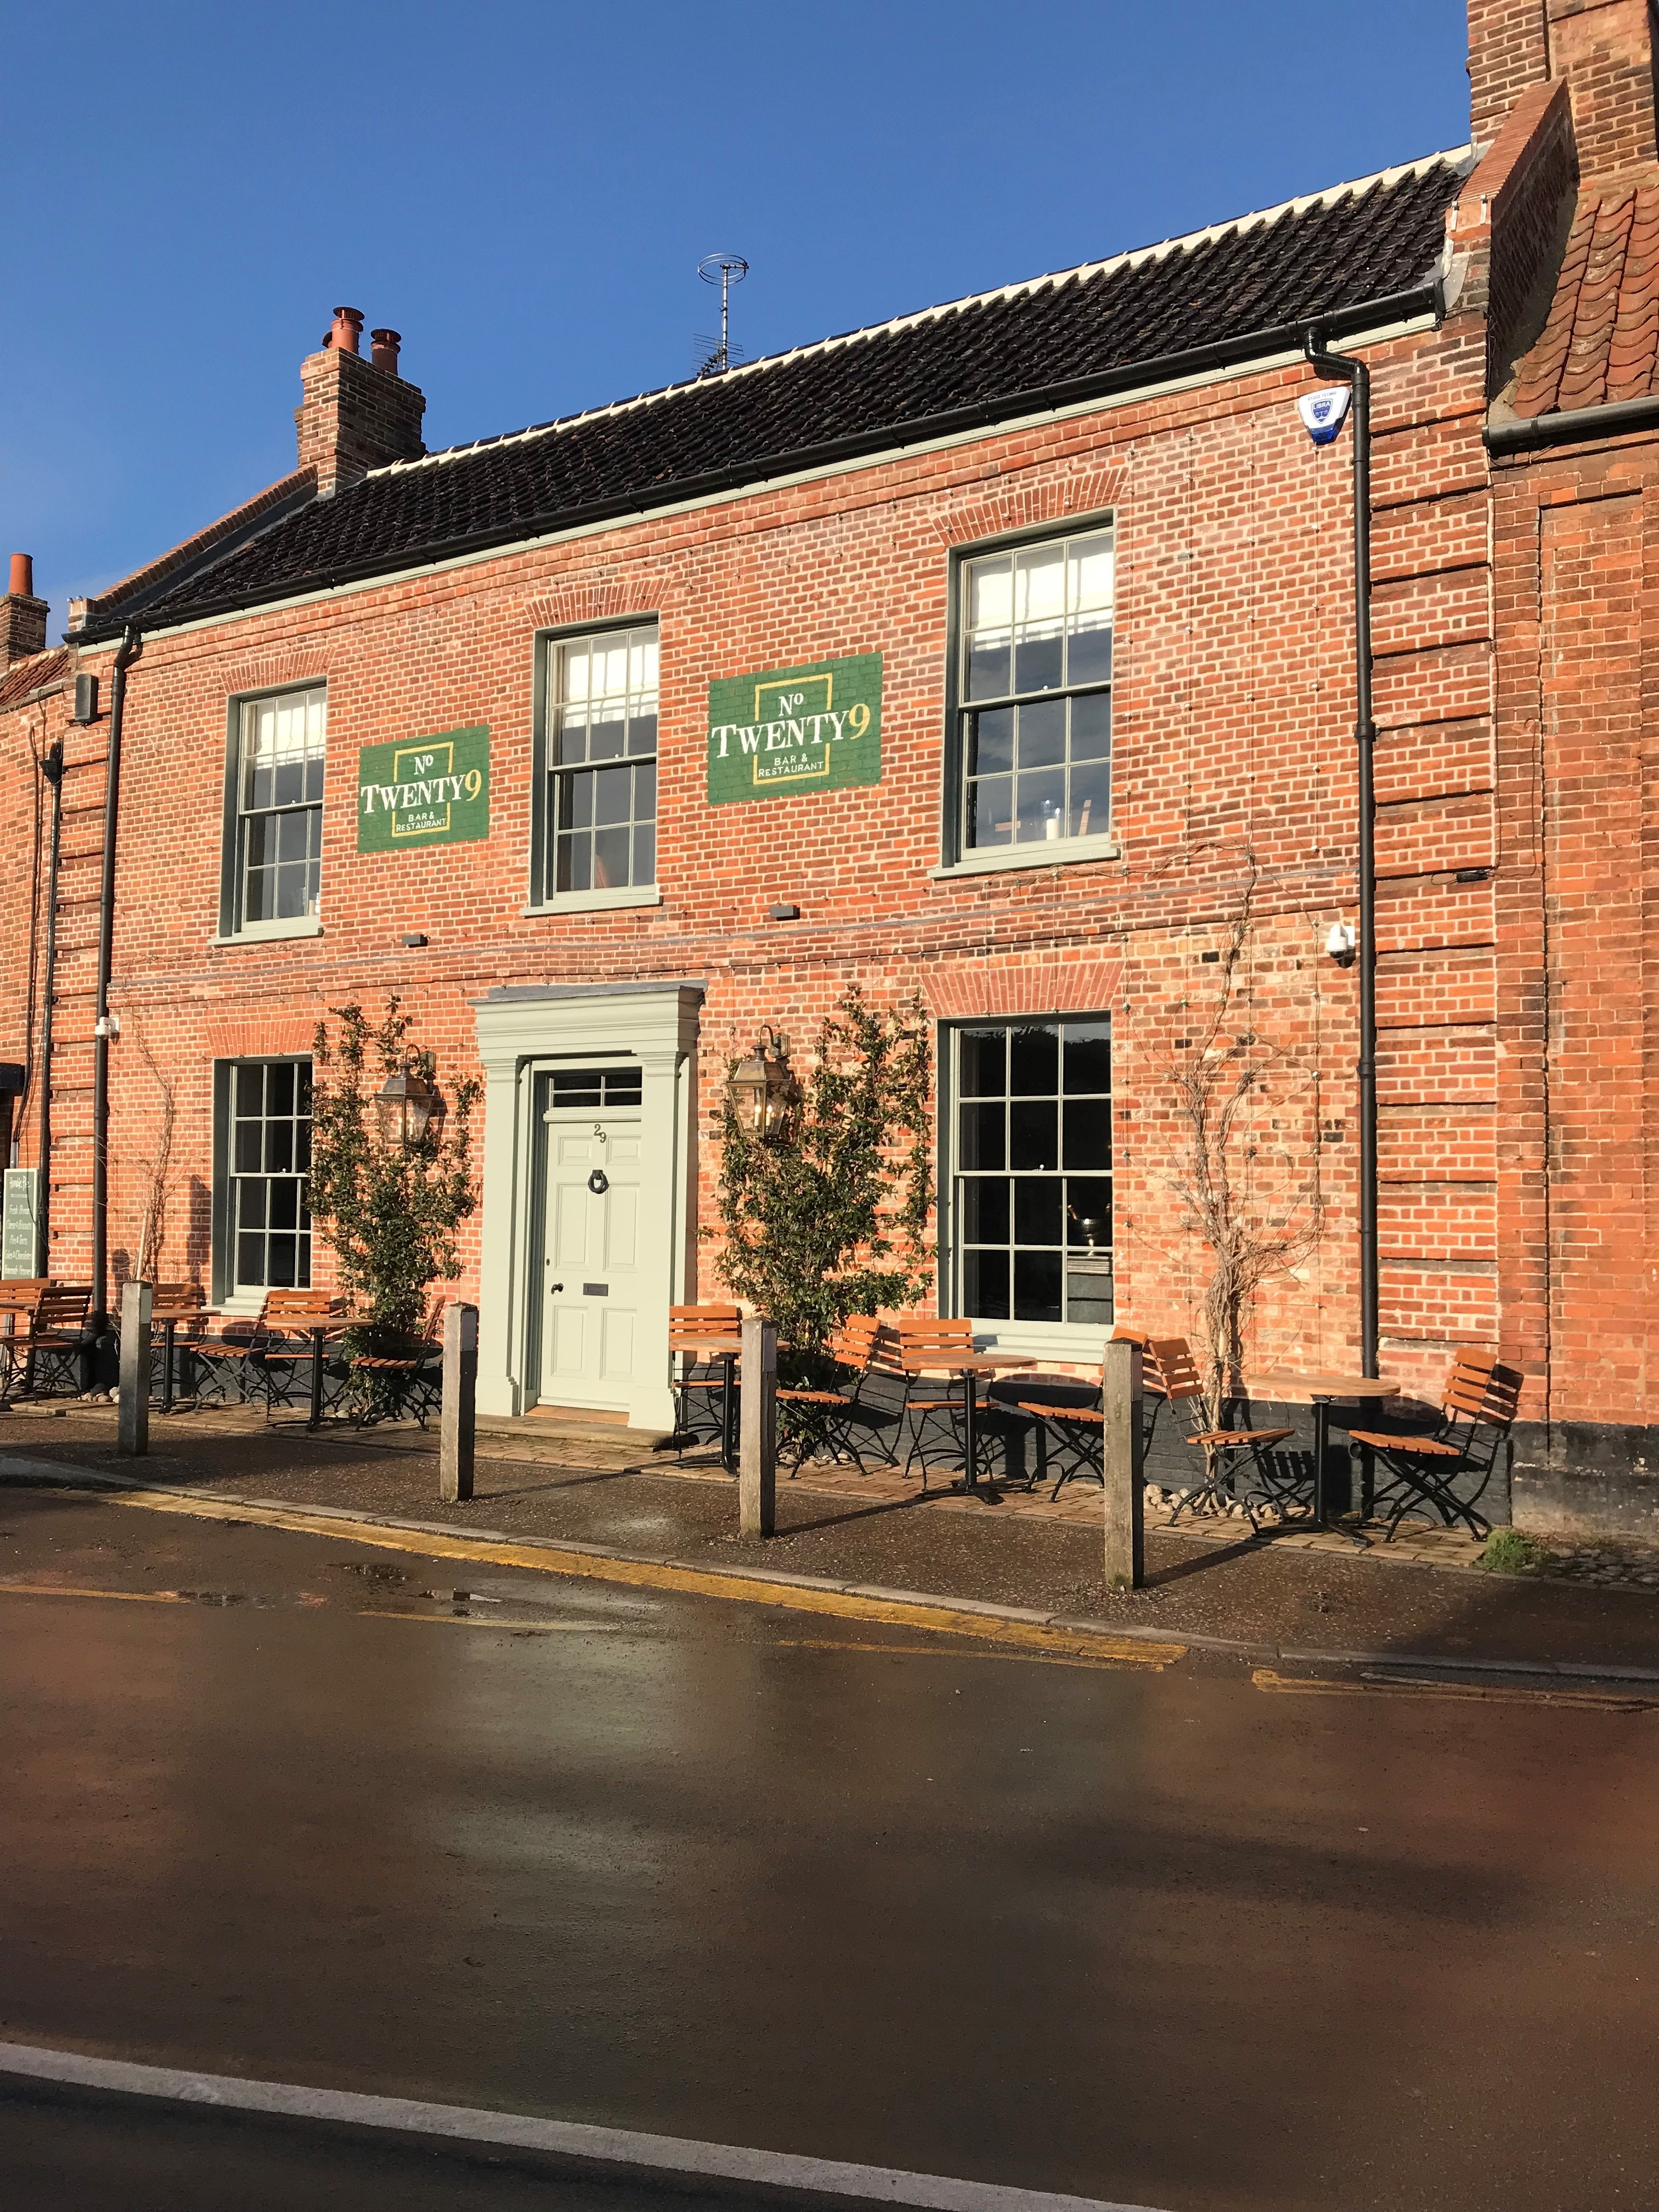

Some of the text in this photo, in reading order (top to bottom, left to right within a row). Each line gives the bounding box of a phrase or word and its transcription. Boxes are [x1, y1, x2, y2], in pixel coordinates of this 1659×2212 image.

[1313, 401, 1330, 409] LIBRA
[774, 753, 808, 766] BAR &
[758, 761, 824, 777] RESTAURANT
[408, 811, 435, 822] BAR &
[396, 818, 447, 833] RESTAURANT
[594, 1124, 606, 1143] 29
